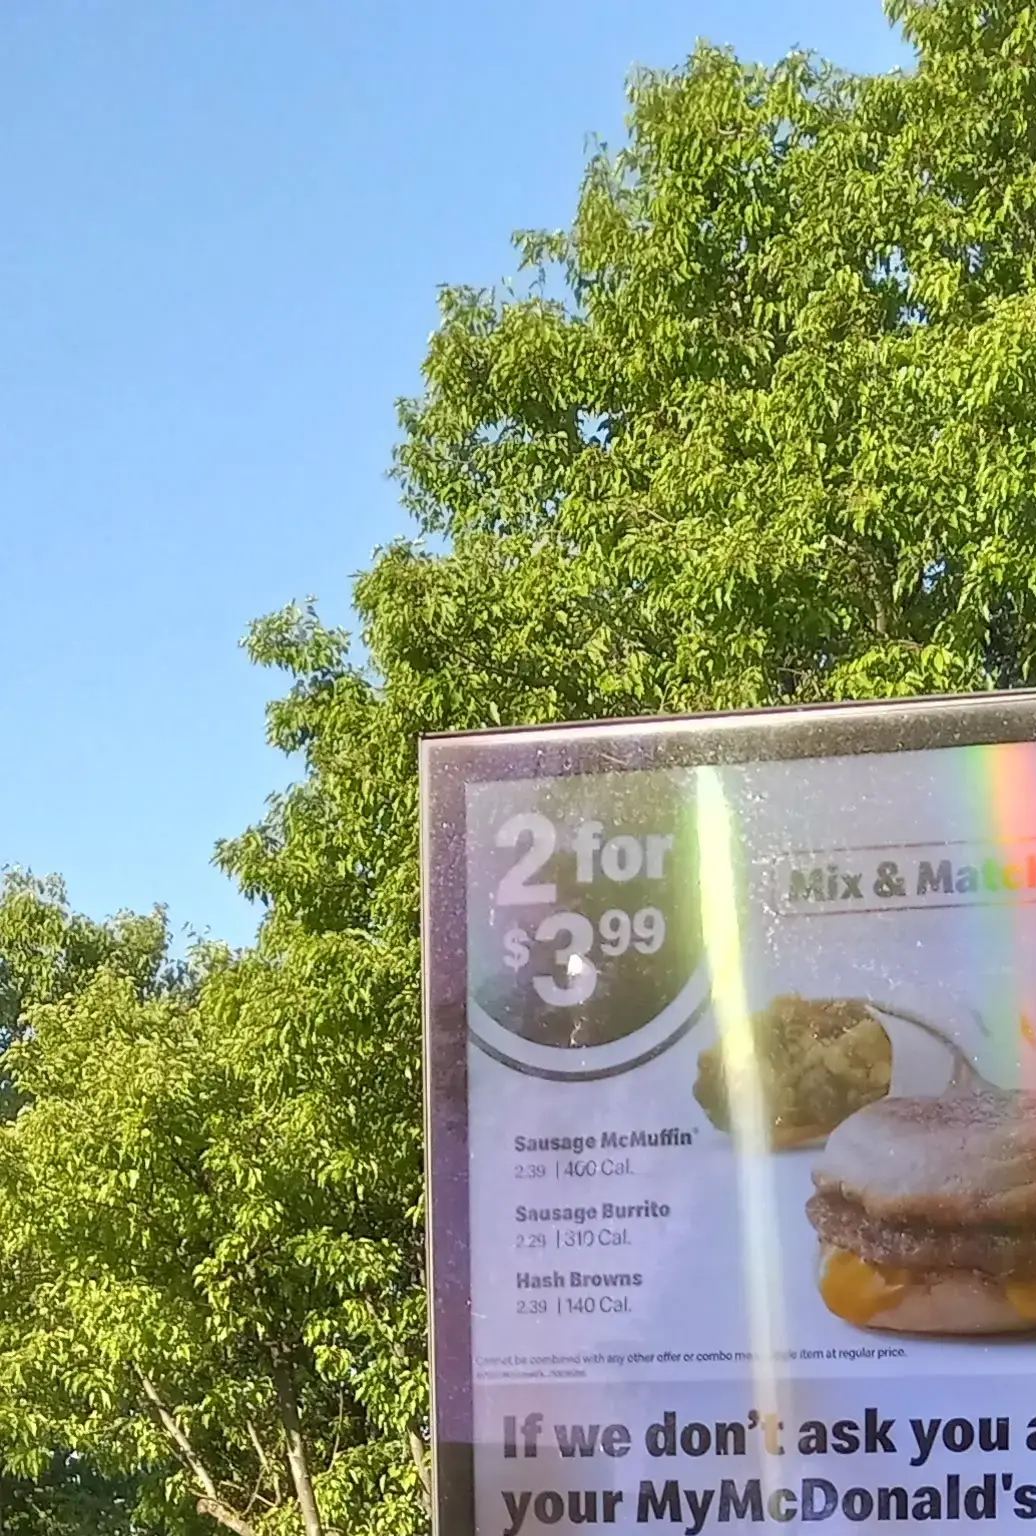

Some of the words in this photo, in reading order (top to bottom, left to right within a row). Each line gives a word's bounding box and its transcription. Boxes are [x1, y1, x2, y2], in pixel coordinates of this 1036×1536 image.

[496, 813, 557, 905] 2
[572, 821, 674, 883] for
[790, 864, 863, 901] Mix
[873, 861, 906, 897] &
[514, 1135, 596, 1154] Sausage
[515, 1164, 546, 1179] 2.39
[601, 1158, 633, 1176] Cal.
[516, 1205, 597, 1224] Sausage
[602, 1200, 670, 1219] Burrito
[564, 1229, 594, 1247] 310
[598, 1229, 631, 1246] Cal.
[516, 1271, 565, 1289] Hash
[570, 1272, 642, 1287] Browns
[517, 1299, 547, 1314] 2.39
[567, 1297, 595, 1313] 140
[600, 1296, 631, 1313] Cal.
[607, 1353, 625, 1366] any
[627, 1352, 655, 1363] other
[657, 1350, 680, 1362] offer
[684, 1353, 694, 1362] or
[696, 1350, 732, 1362] combo
[826, 1348, 836, 1359] at
[839, 1347, 875, 1360] regular
[878, 1347, 907, 1360] price.
[502, 1412, 543, 1458] If
[554, 1422, 631, 1457] we
[797, 1407, 896, 1455] ask
[909, 1415, 1010, 1468] you
[501, 1488, 623, 1536] your
